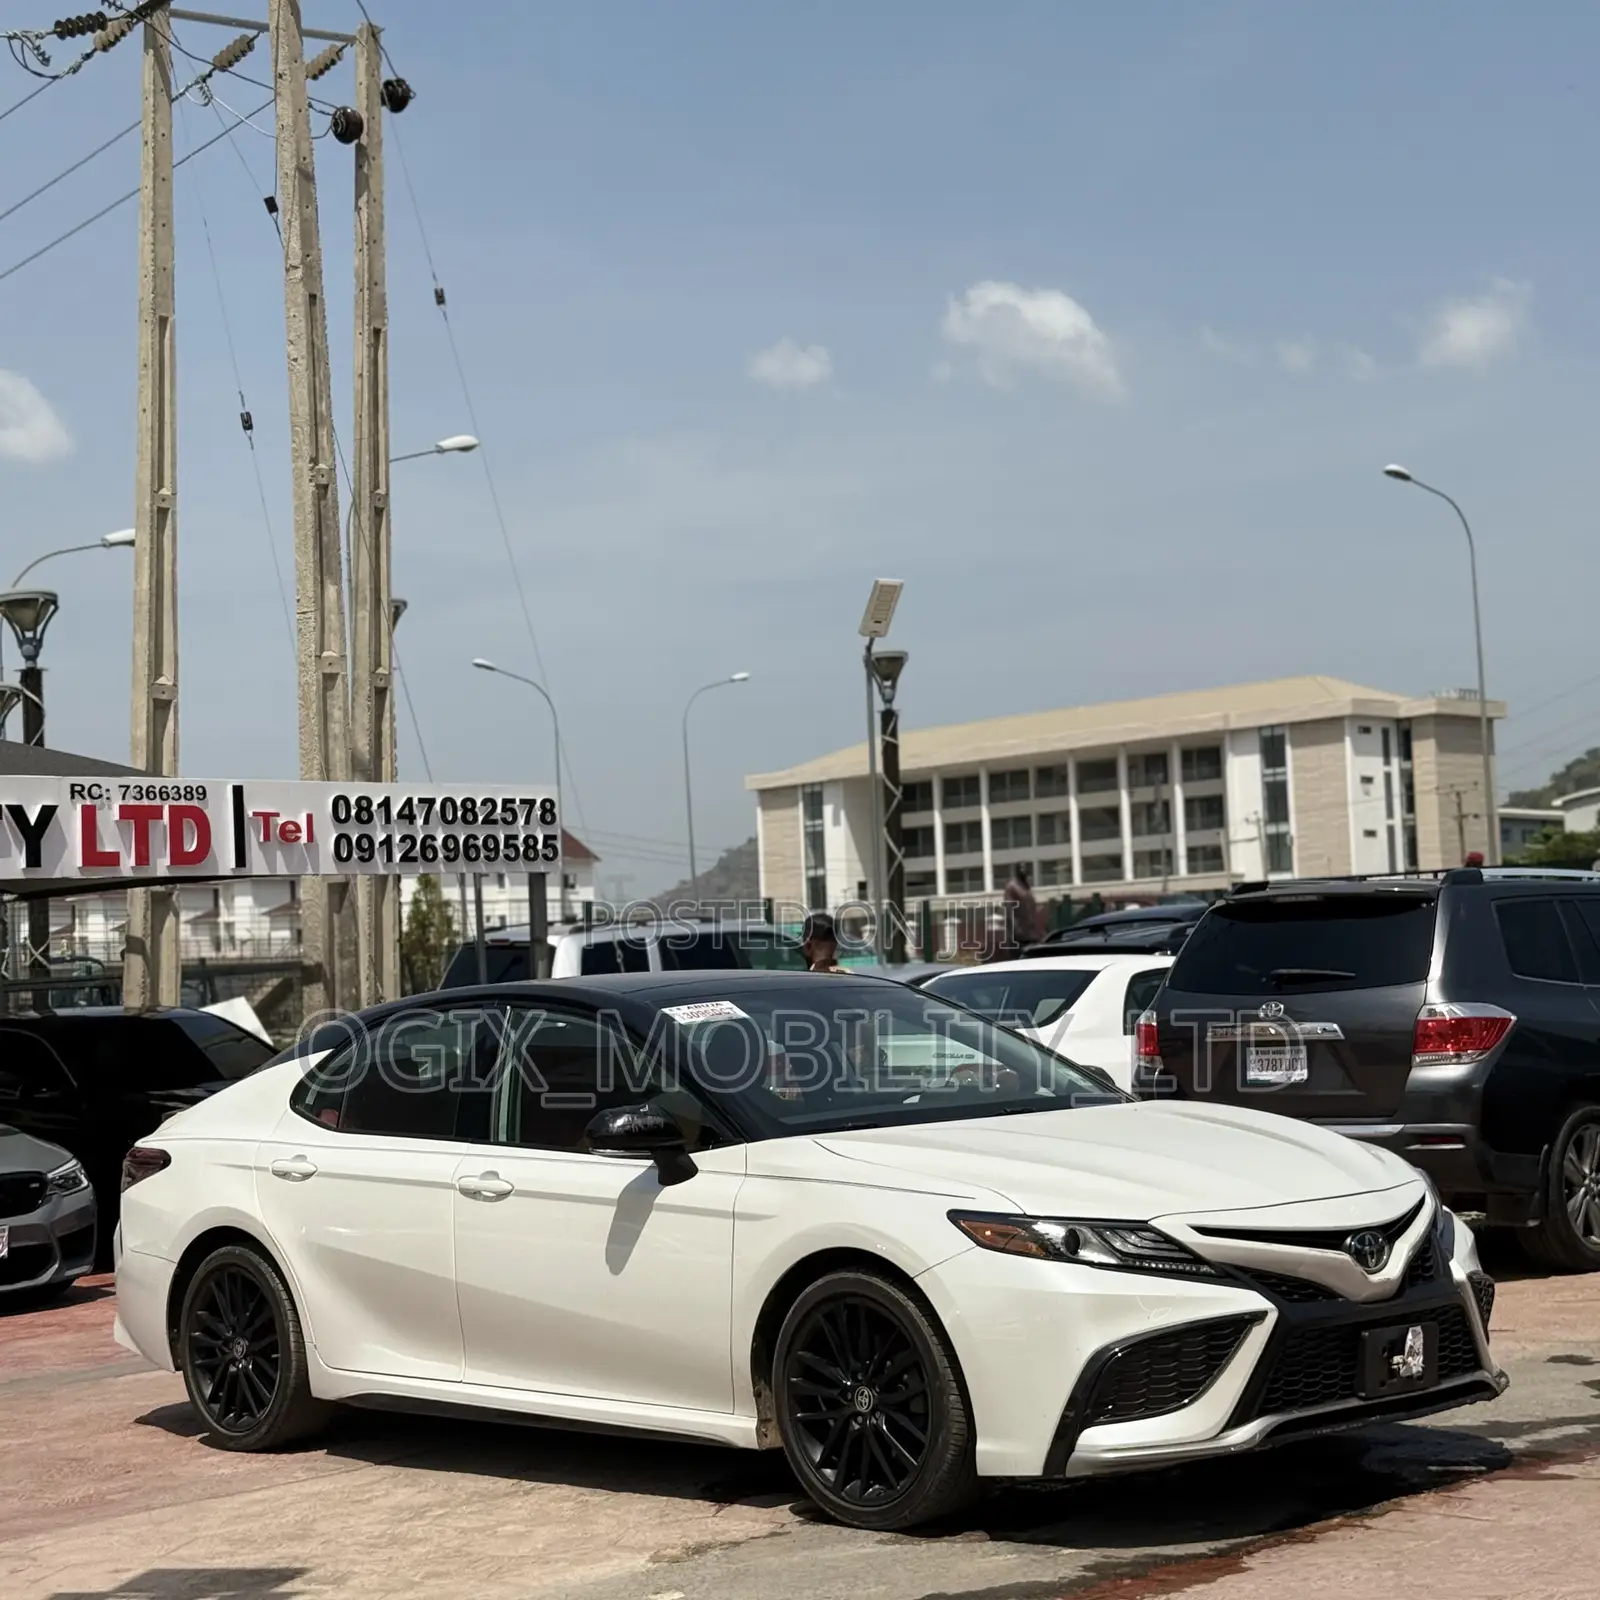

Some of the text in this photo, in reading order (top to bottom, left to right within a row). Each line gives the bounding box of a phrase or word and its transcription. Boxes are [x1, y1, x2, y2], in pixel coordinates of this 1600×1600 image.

[69, 783, 208, 801] RC: 7366389
[331, 795, 557, 826] 08147082578
[80, 804, 212, 867] LTD
[251, 811, 314, 843] Tel
[333, 833, 559, 864] 09126969585
